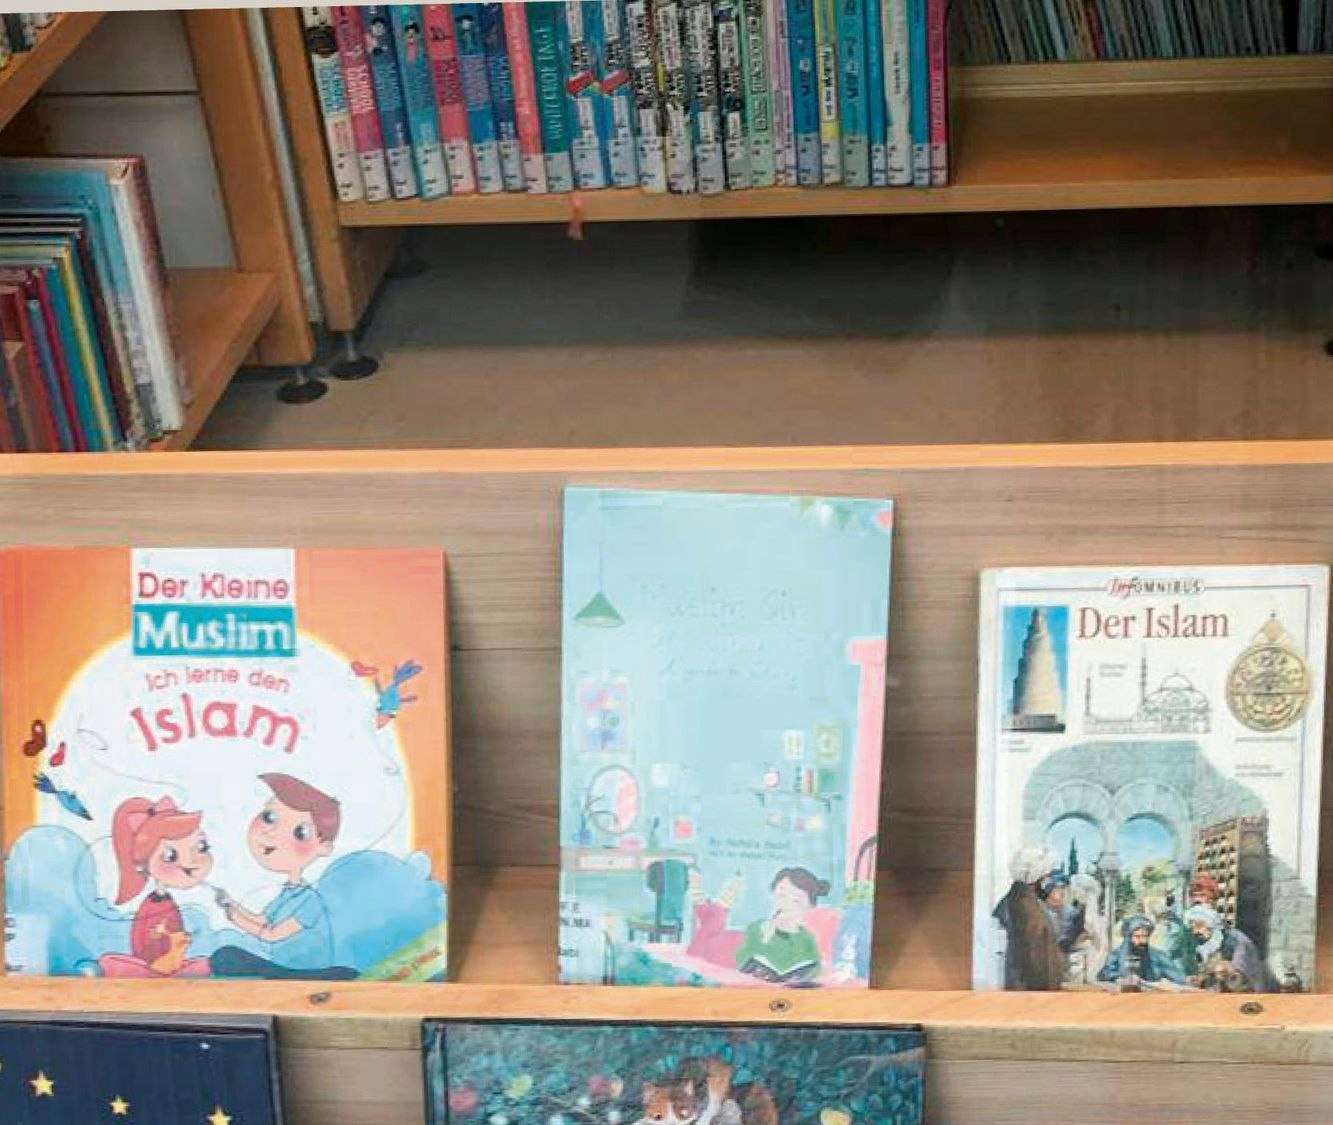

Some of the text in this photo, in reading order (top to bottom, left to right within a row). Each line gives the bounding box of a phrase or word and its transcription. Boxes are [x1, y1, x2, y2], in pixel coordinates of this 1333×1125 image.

[138, 573, 290, 600] Der Kleine
[134, 611, 293, 651] Muslim
[1078, 603, 1229, 639] Der Islam
[145, 666, 290, 694] Ich lerne den
[130, 692, 301, 754] Islam
